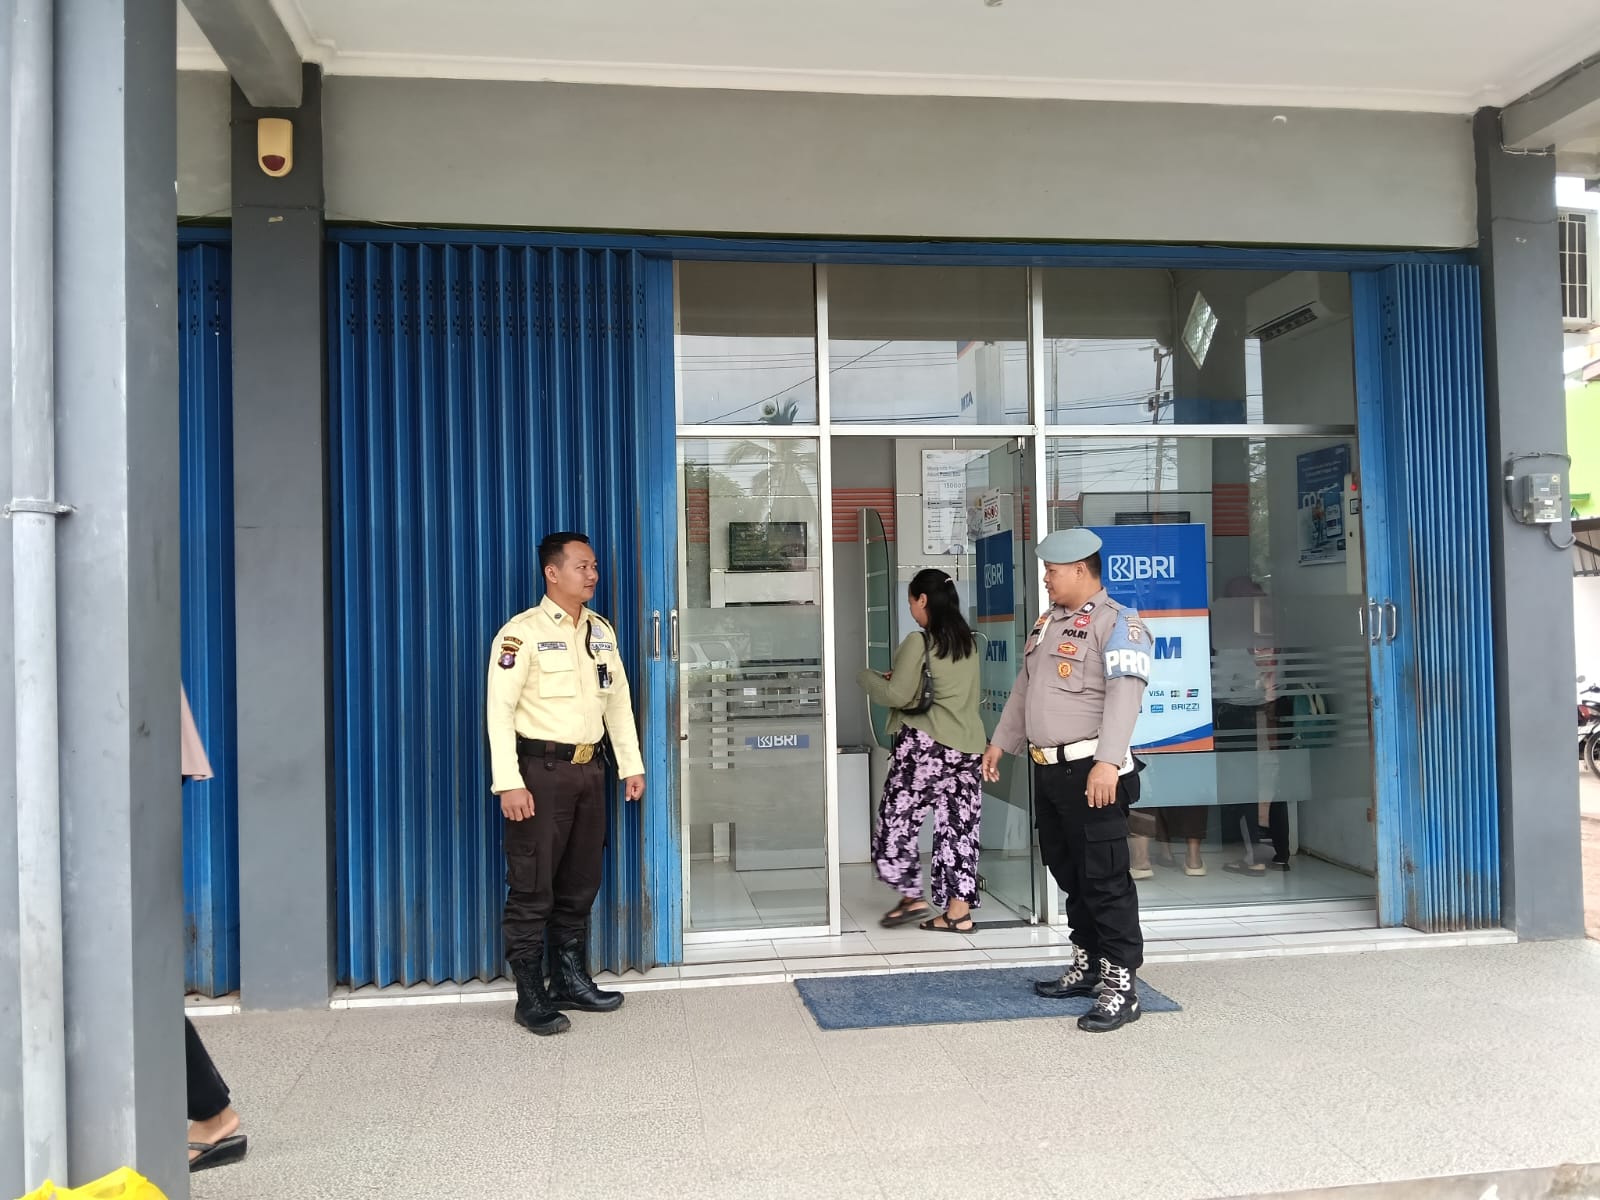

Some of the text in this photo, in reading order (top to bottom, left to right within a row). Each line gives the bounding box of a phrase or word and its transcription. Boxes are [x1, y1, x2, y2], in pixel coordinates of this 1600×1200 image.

[991, 562, 1004, 585] BRI
[1135, 556, 1175, 579] BRI
[1062, 628, 1088, 640] POLRI
[985, 640, 1007, 662] ATM
[773, 734, 797, 746] BRI
